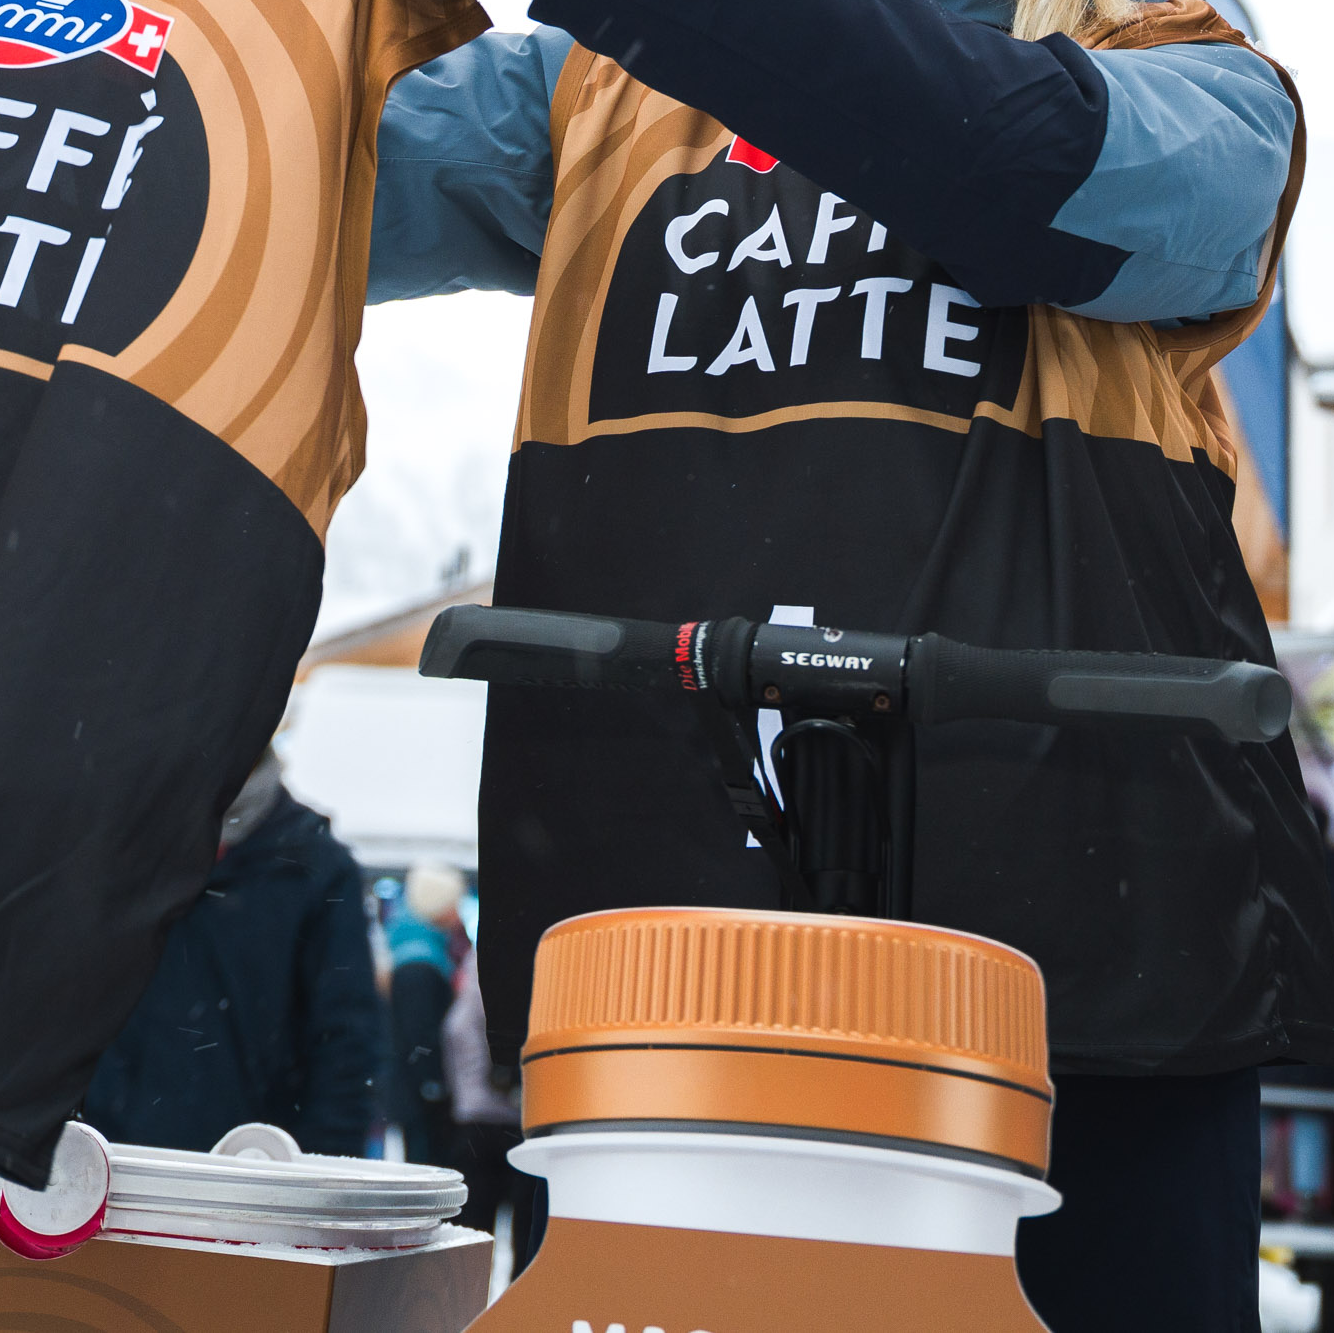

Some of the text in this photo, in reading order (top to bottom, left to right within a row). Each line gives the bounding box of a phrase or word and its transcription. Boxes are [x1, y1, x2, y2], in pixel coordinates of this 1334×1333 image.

[664, 192, 888, 276] CAF
[646, 277, 983, 378] LATTE
[780, 651, 874, 671] SEGWAY
